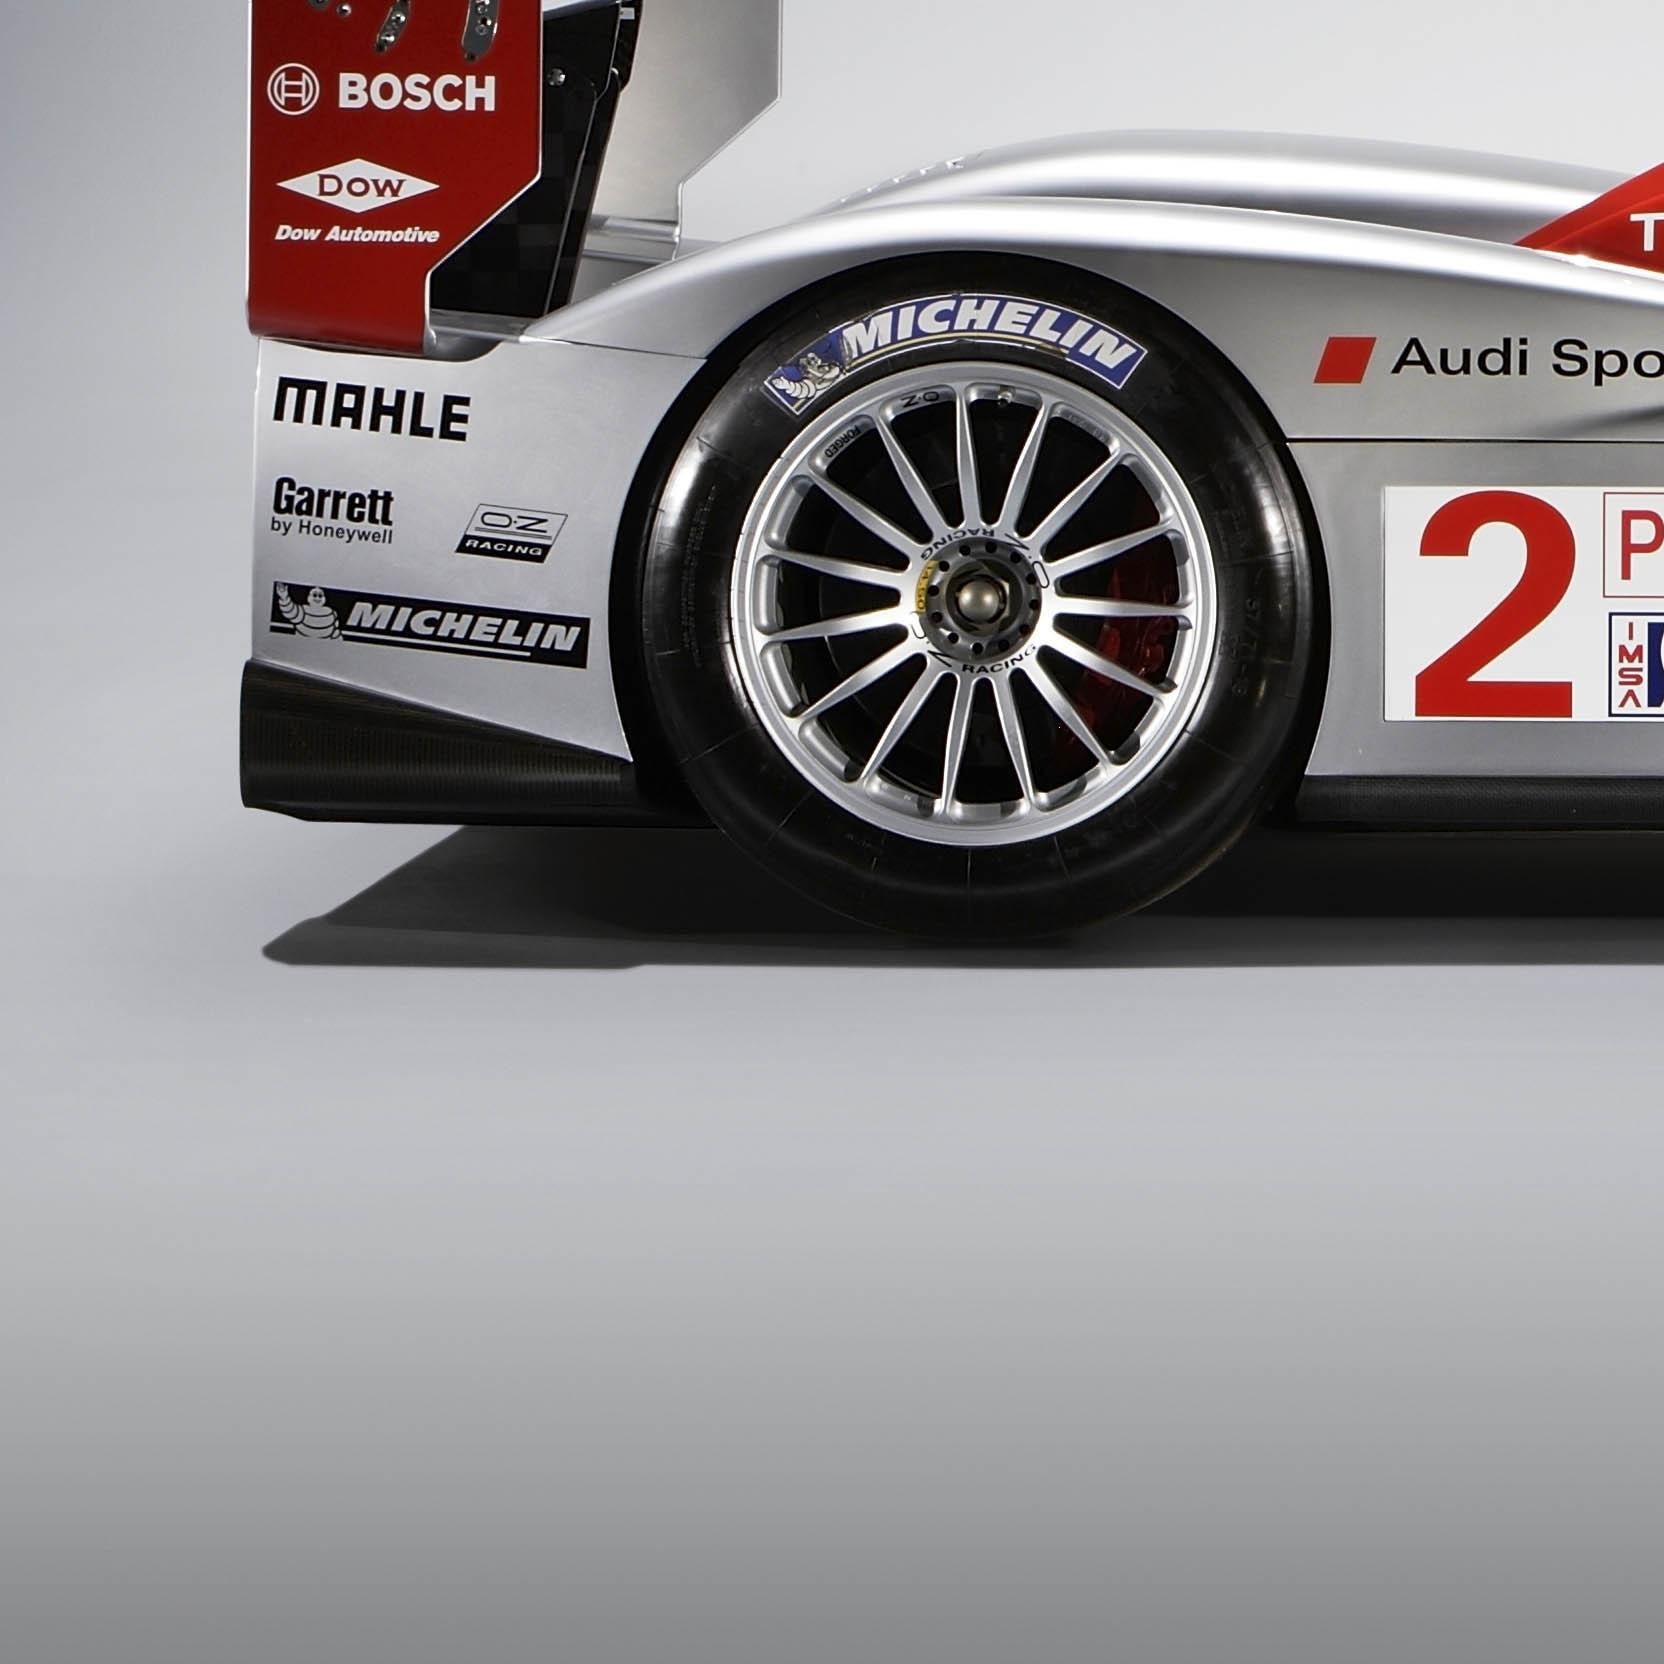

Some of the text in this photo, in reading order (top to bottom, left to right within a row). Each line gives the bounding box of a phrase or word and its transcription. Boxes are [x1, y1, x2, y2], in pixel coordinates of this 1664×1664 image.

[338, 72, 496, 112] BOSCH
[275, 224, 441, 243] Dow Automotive
[842, 298, 1138, 370] MICHELIN
[1390, 336, 1528, 376] Audi
[272, 376, 471, 442] MAHLE
[272, 477, 394, 526] Garrett
[271, 516, 394, 545] by Honeywell
[465, 538, 543, 557] RACING
[920, 527, 996, 561] RACING
[1415, 489, 1576, 718] 2
[345, 601, 581, 652] MICHELIN
[1618, 621, 1644, 709] IMSA
